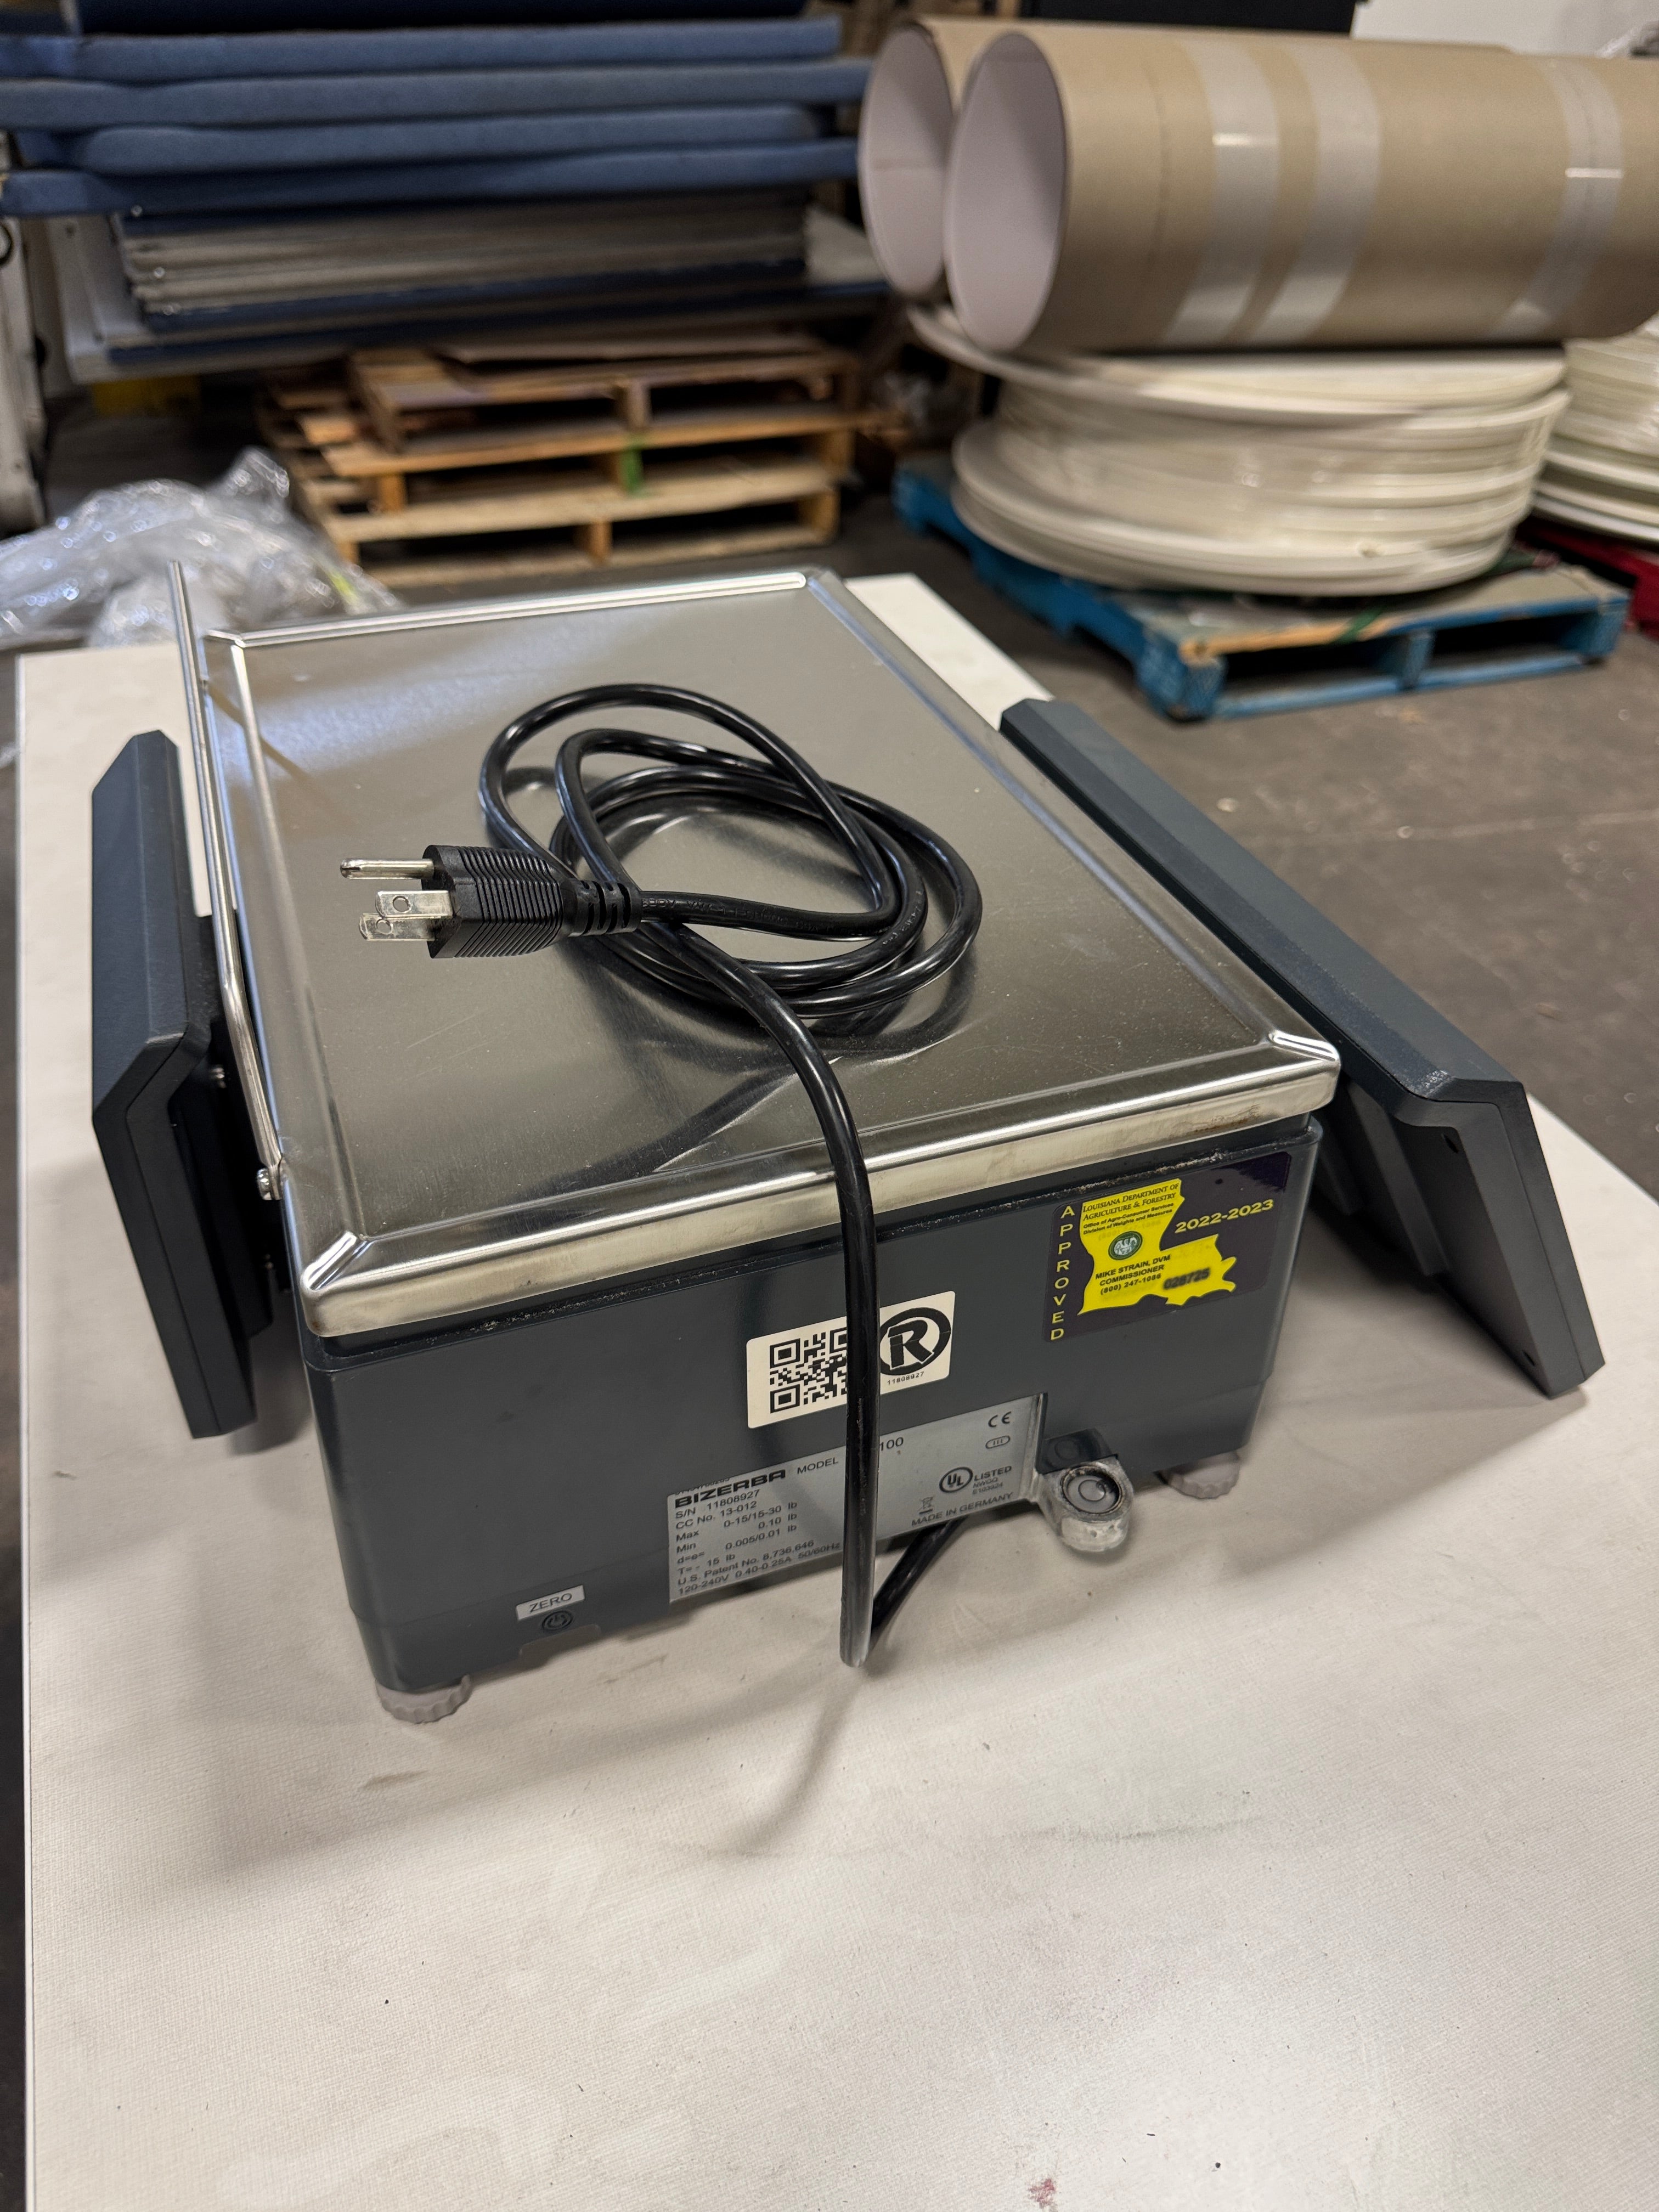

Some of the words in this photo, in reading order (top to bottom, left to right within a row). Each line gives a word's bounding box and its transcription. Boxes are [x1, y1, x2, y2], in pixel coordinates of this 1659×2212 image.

[1083, 1198, 1120, 1212] LOUISIANA
[1122, 1186, 1168, 1203] DEPARTMENT
[1083, 1203, 1131, 1221] AGRICULTURE
[1142, 1192, 1177, 1206] FORESTRY
[1108, 1208, 1150, 1222] Agro-Consumer
[1151, 1203, 1173, 1211] Services
[1084, 1226, 1105, 1234] Division
[1113, 1218, 1134, 1228] Weights
[1147, 1209, 1172, 1218] Measures
[1175, 1199, 1274, 1233] 2022-2023
[1050, 1205, 1075, 1340] APPROVED
[1096, 1268, 1116, 1279] MIKE
[1118, 1261, 1150, 1273] STRAIN,
[1153, 1255, 1171, 1264] DVM
[1100, 1265, 1164, 1286] COMMISSIONER
[1101, 1284, 1121, 1295] (800)
[887, 1371, 924, 1385] 11808927
[675, 1469, 786, 1508] BIZERBA
[797, 1457, 838, 1474] MODEL
[974, 1466, 1012, 1481] LISTED
[675, 1507, 696, 1519] S/N
[707, 1489, 760, 1510] 11808927
[676, 1519, 693, 1529] CC
[697, 1515, 715, 1524] No.
[720, 1500, 757, 1516] 13-012
[912, 1512, 943, 1526] MADE
[946, 1508, 956, 1516] IN
[960, 1492, 1013, 1511] GERMANY
[676, 1530, 699, 1542] Max
[724, 1505, 781, 1528] 0-15/15-30
[676, 1543, 696, 1554] Min
[758, 1517, 781, 1529] 0.10
[678, 1551, 705, 1564] d=e=
[725, 1528, 780, 1550] 0.005/0.01
[678, 1575, 701, 1585] U.S.
[704, 1563, 738, 1578] Patent
[742, 1558, 759, 1567] No.
[679, 1574, 729, 1594] 120-240V
[798, 1542, 840, 1559] 50/60Hz
[707, 1557, 720, 1566] 15
[530, 1593, 572, 1613] ZERO
